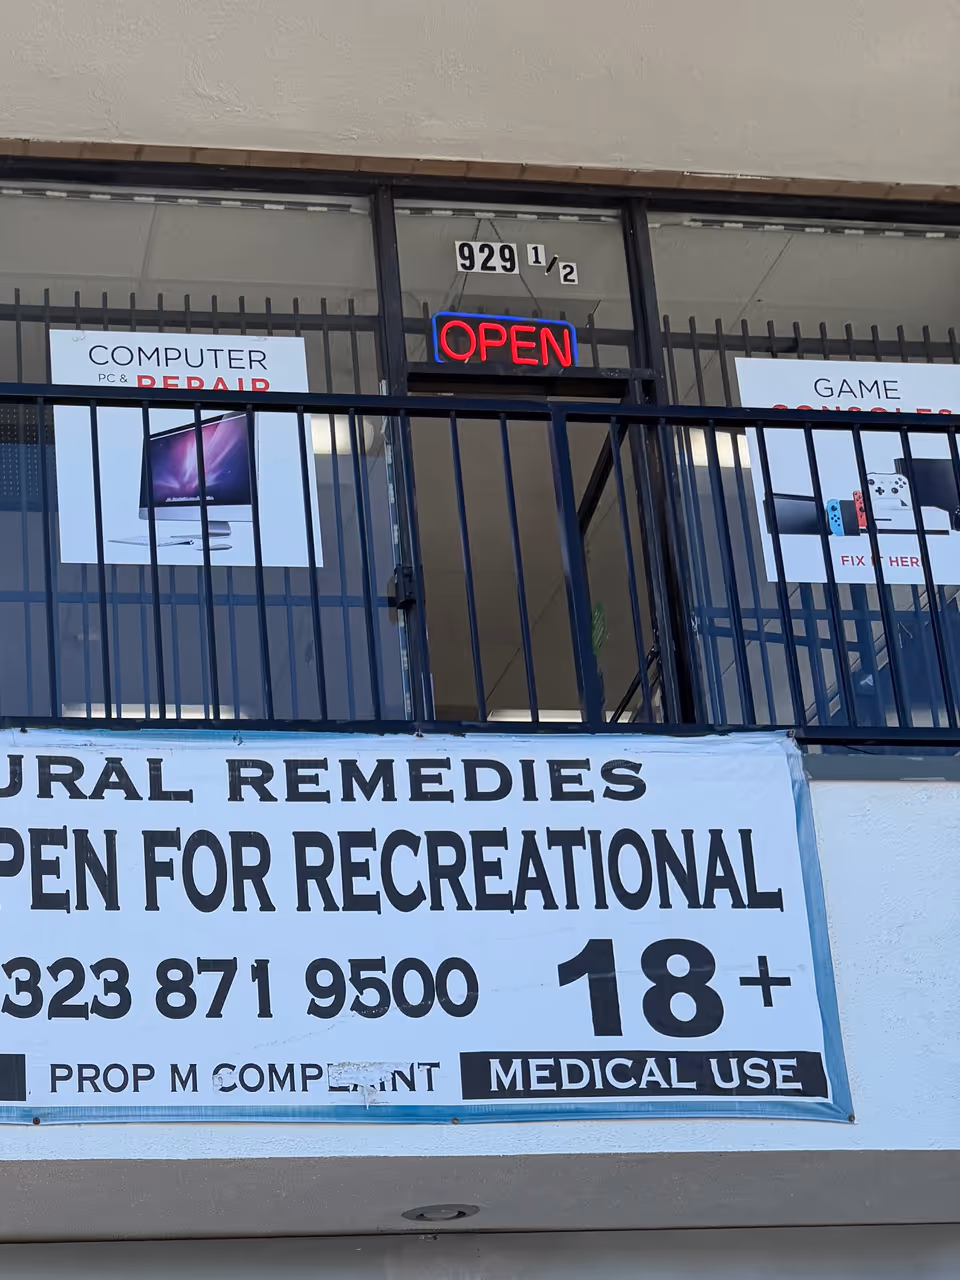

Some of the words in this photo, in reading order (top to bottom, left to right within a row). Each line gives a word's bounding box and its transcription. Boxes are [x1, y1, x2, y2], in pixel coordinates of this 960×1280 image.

[458, 242, 516, 273] 929
[88, 345, 268, 370] COMPUTER
[440, 320, 572, 367] OPEN
[98, 373, 115, 383] PC
[120, 373, 128, 383] &
[814, 378, 901, 400] GAME
[840, 555, 866, 567] FIX
[888, 556, 921, 568] HER
[226, 756, 648, 804] REMEDIES
[141, 826, 276, 913] FOR
[291, 826, 785, 914] RECREATIONAL
[1, 956, 132, 1020] 323
[155, 956, 274, 1020] 871
[305, 955, 479, 1020] 9500
[557, 938, 792, 1038] 18+
[49, 1063, 156, 1094] PROP
[169, 1063, 199, 1093] M
[213, 1060, 441, 1093] COMPLNT
[489, 1057, 697, 1091] MEDICAL
[708, 1057, 804, 1090] USE
